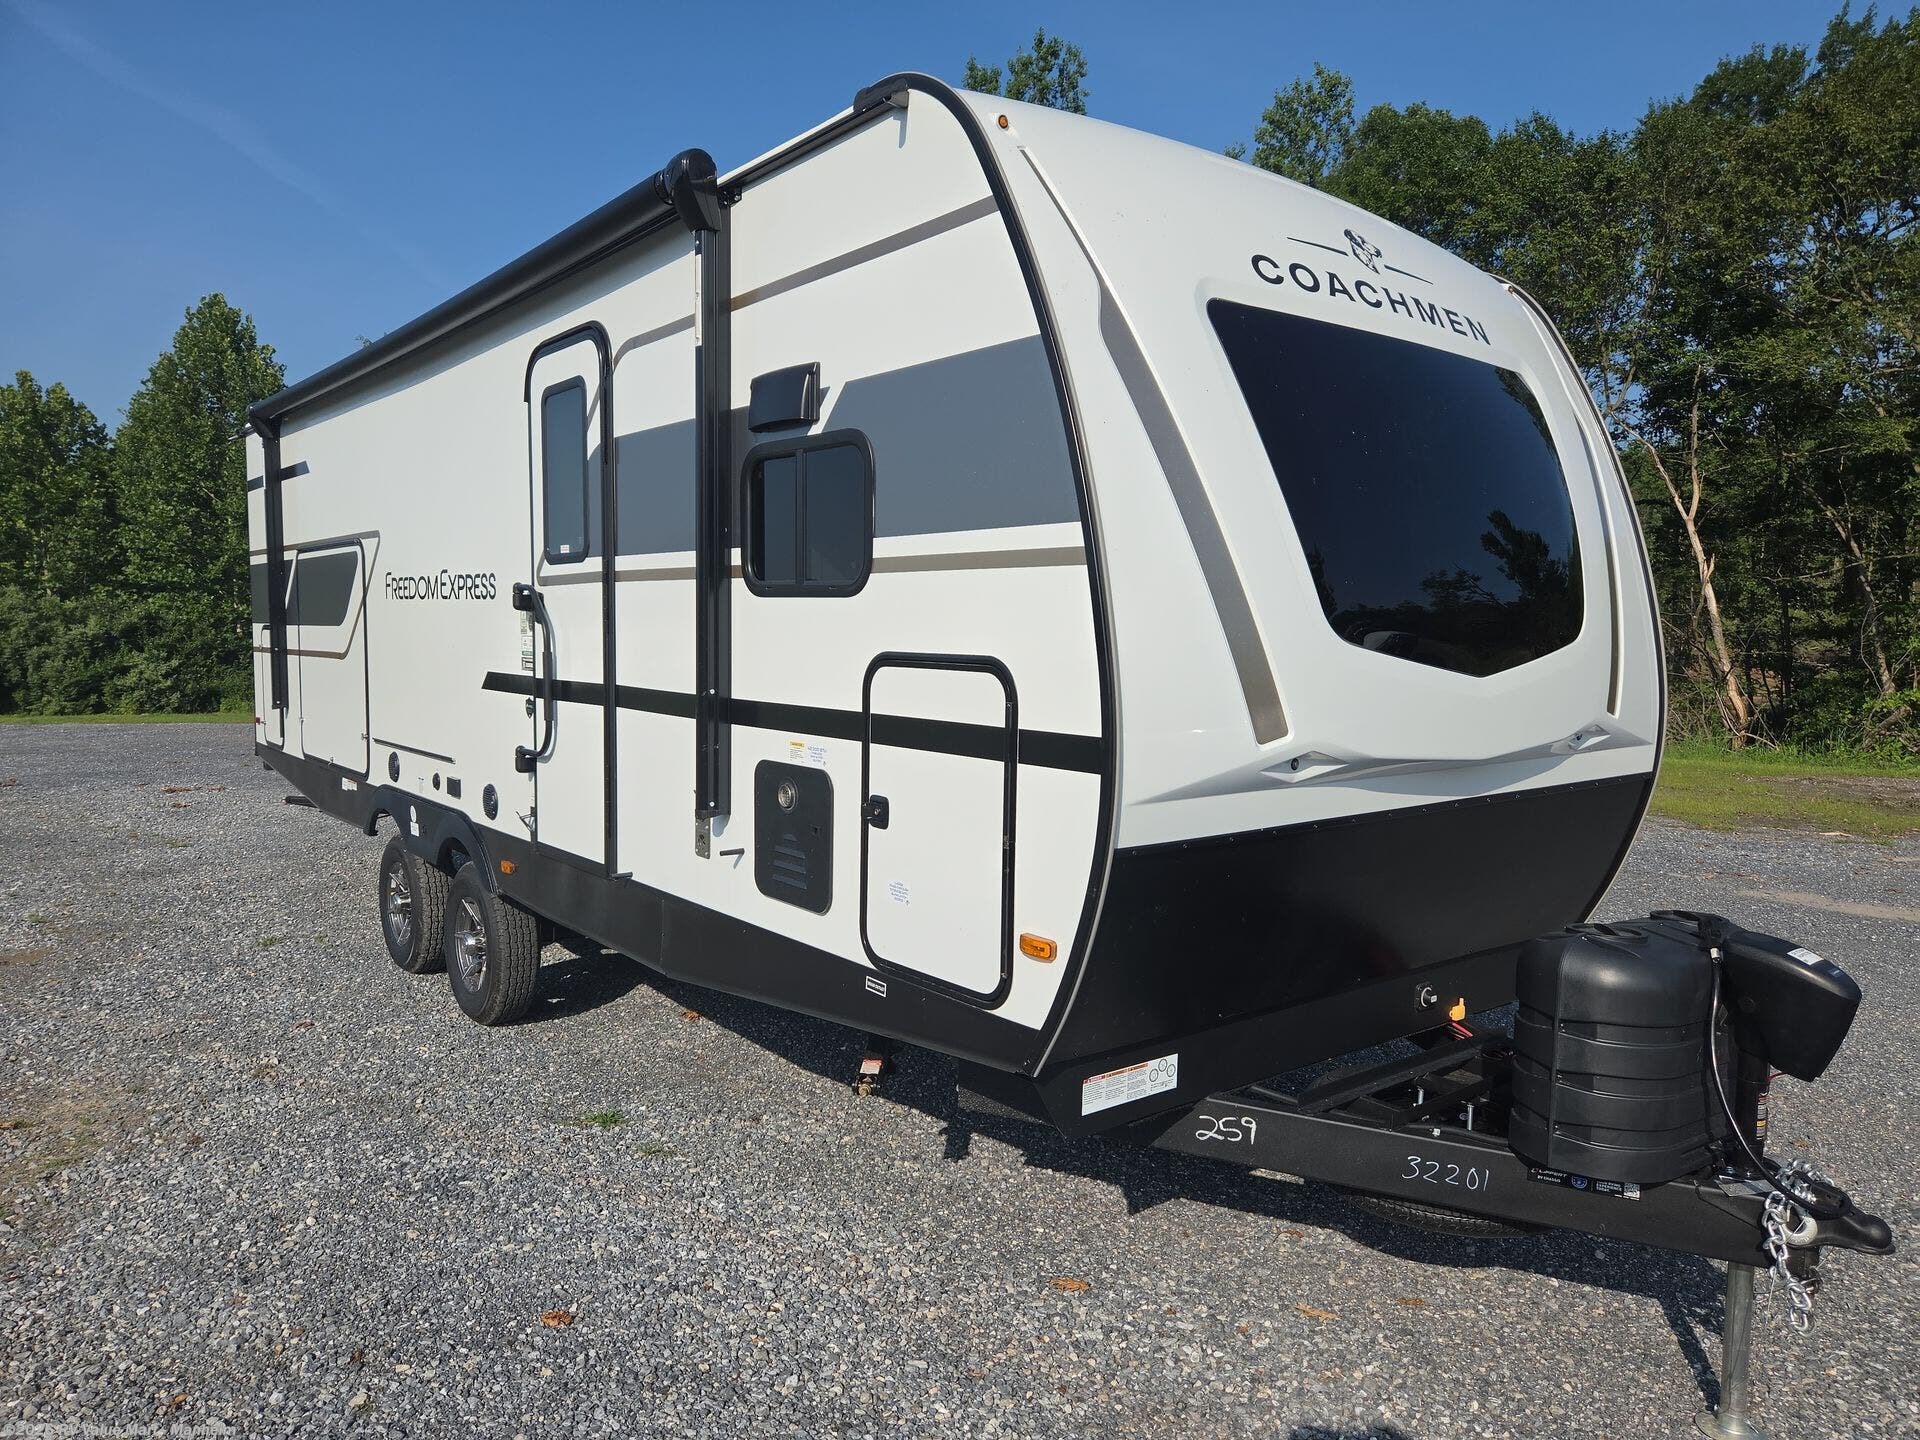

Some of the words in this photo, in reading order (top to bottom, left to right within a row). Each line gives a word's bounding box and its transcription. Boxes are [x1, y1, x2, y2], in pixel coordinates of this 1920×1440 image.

[1251, 254, 1491, 346] COACHMEN
[1195, 1115, 1257, 1145] 259
[1401, 1155, 1490, 1191] 32201
